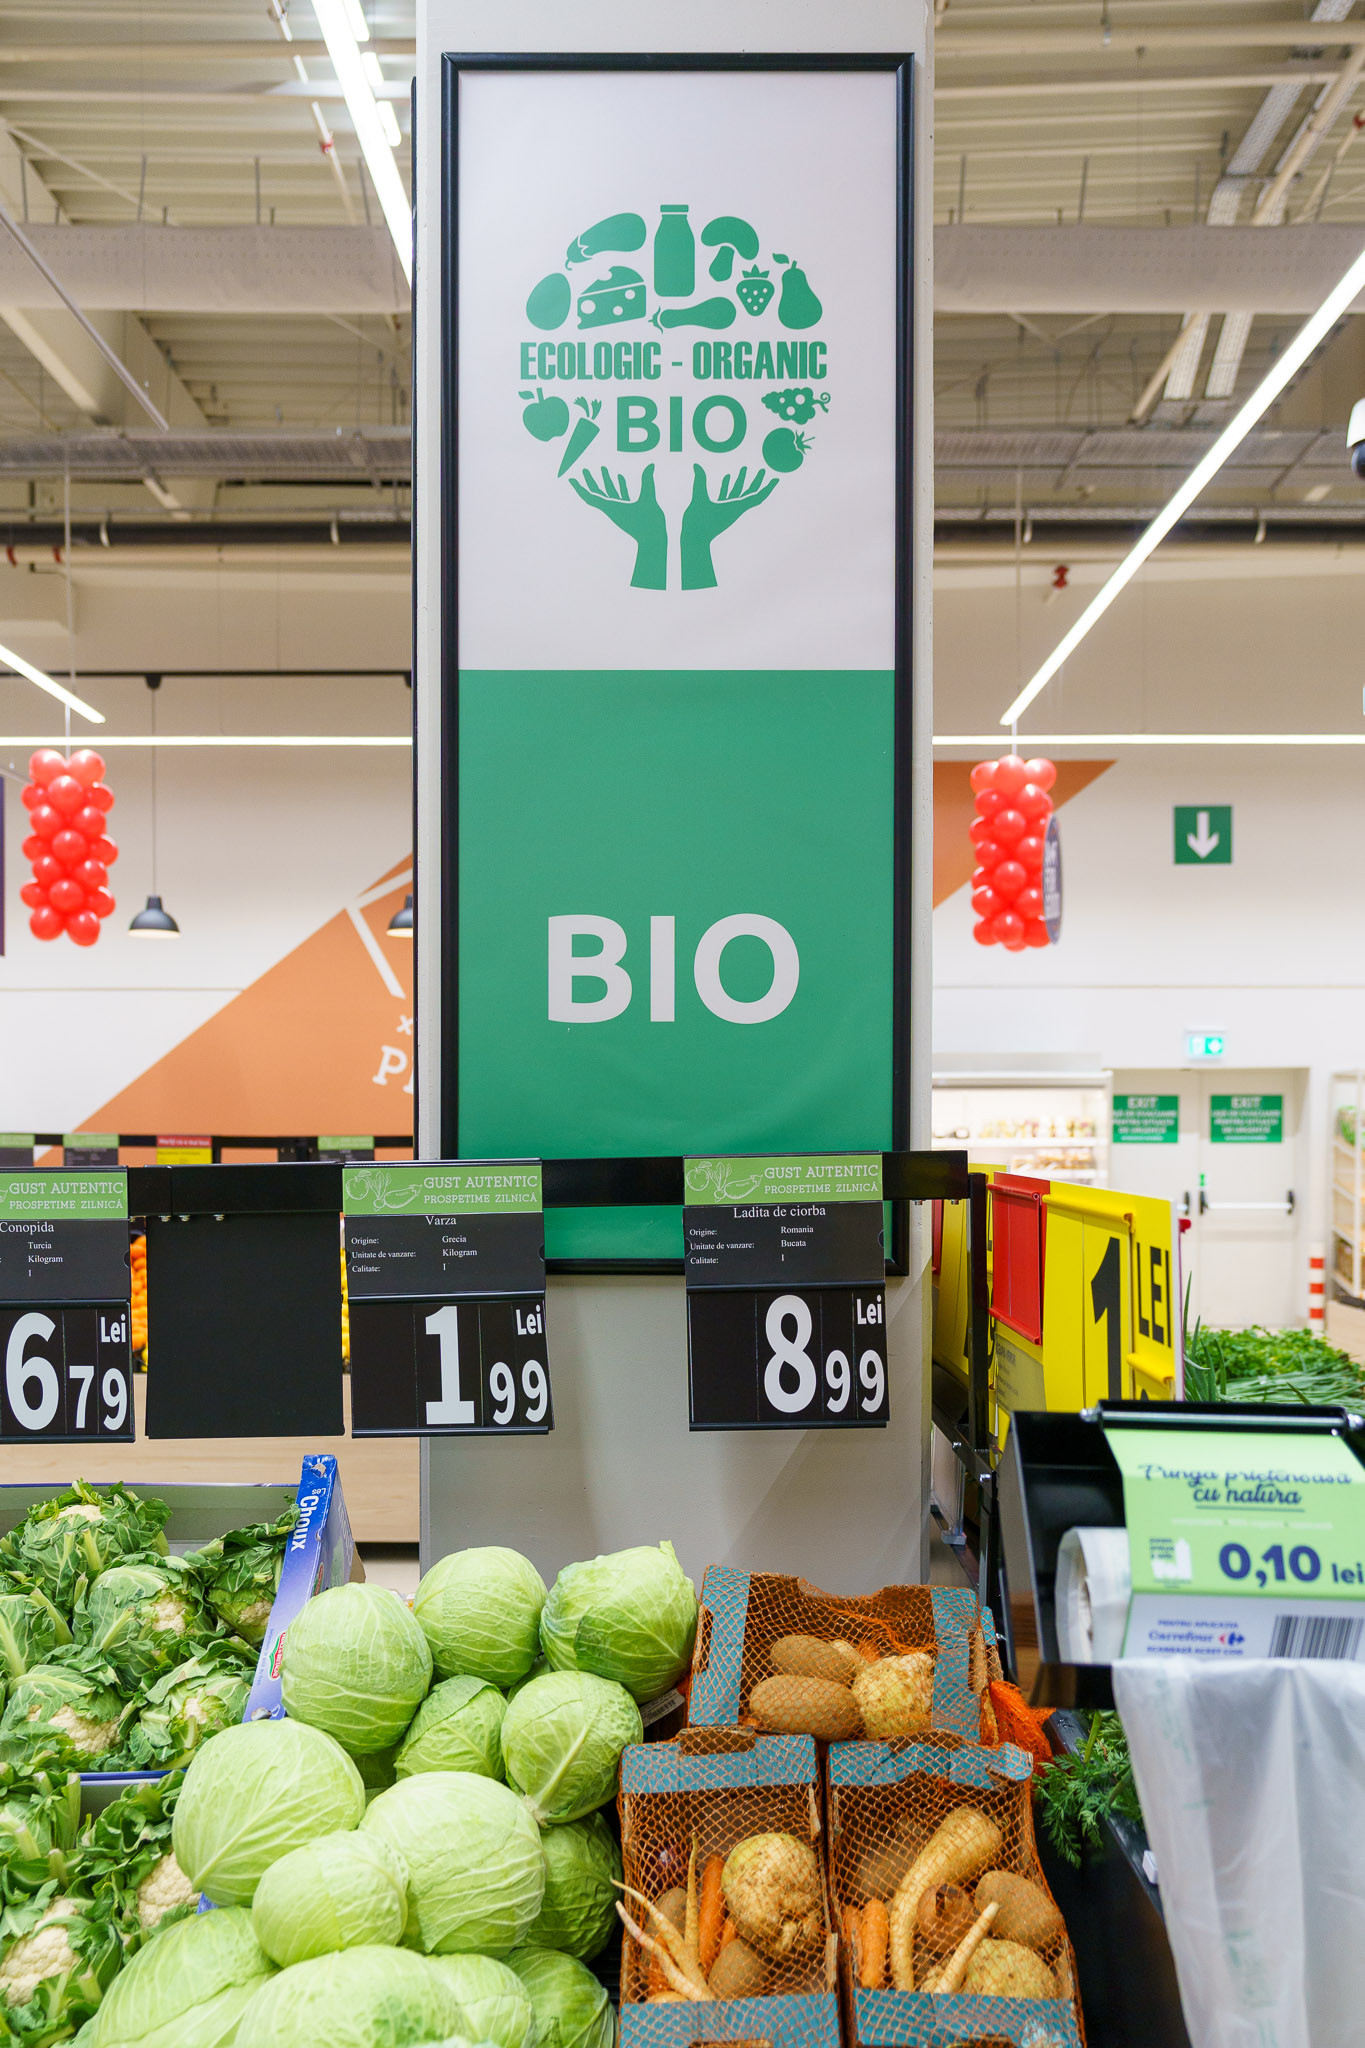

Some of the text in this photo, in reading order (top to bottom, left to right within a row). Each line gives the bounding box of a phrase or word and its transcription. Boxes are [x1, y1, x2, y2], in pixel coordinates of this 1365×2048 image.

[521, 342, 661, 380] ECOLOGIC
[693, 341, 827, 380] ORGANIC
[617, 395, 747, 453] BIO
[548, 913, 800, 1024] BIO
[764, 1165, 879, 1179] GUST AUTENTIC
[9, 1182, 124, 1195] GUST AUTENTIC
[423, 1175, 538, 1189] GUST AUTENTIC
[764, 1184, 831, 1194] PROSPETIME
[9, 1200, 76, 1210] PROSPETIME
[424, 1194, 490, 1204] PROSPETIME
[734, 1205, 826, 1218] Ladita de ciorba
[425, 1215, 457, 1226] Varza
[0, 1221, 54, 1235] Conopida
[689, 1226, 814, 1237] Origine: Romania
[28, 1241, 52, 1250] Turcia
[351, 1235, 467, 1245] Origine: Grecia
[28, 1255, 63, 1265] Kilogram
[352, 1251, 377, 1259] Unitate
[442, 1249, 478, 1258] Kilogram
[690, 1257, 719, 1265] Calitate:
[352, 1265, 381, 1273] Calitate:
[1136, 1242, 1171, 1349] LEI
[856, 1295, 883, 1325] Lei
[516, 1304, 543, 1335] Lei
[1090, 1236, 1122, 1400] 1
[100, 1313, 127, 1343] Lei
[764, 1294, 816, 1413] 8
[6, 1312, 59, 1430] 6
[425, 1305, 475, 1425] 1
[1138, 1464, 1218, 1488] Punga
[311, 1487, 327, 1496] Les
[1193, 1483, 1303, 1504] cu natura
[291, 1495, 319, 1552] Choux
[1219, 1542, 1321, 1588] 0,10
[1331, 1562, 1365, 1585] lei
